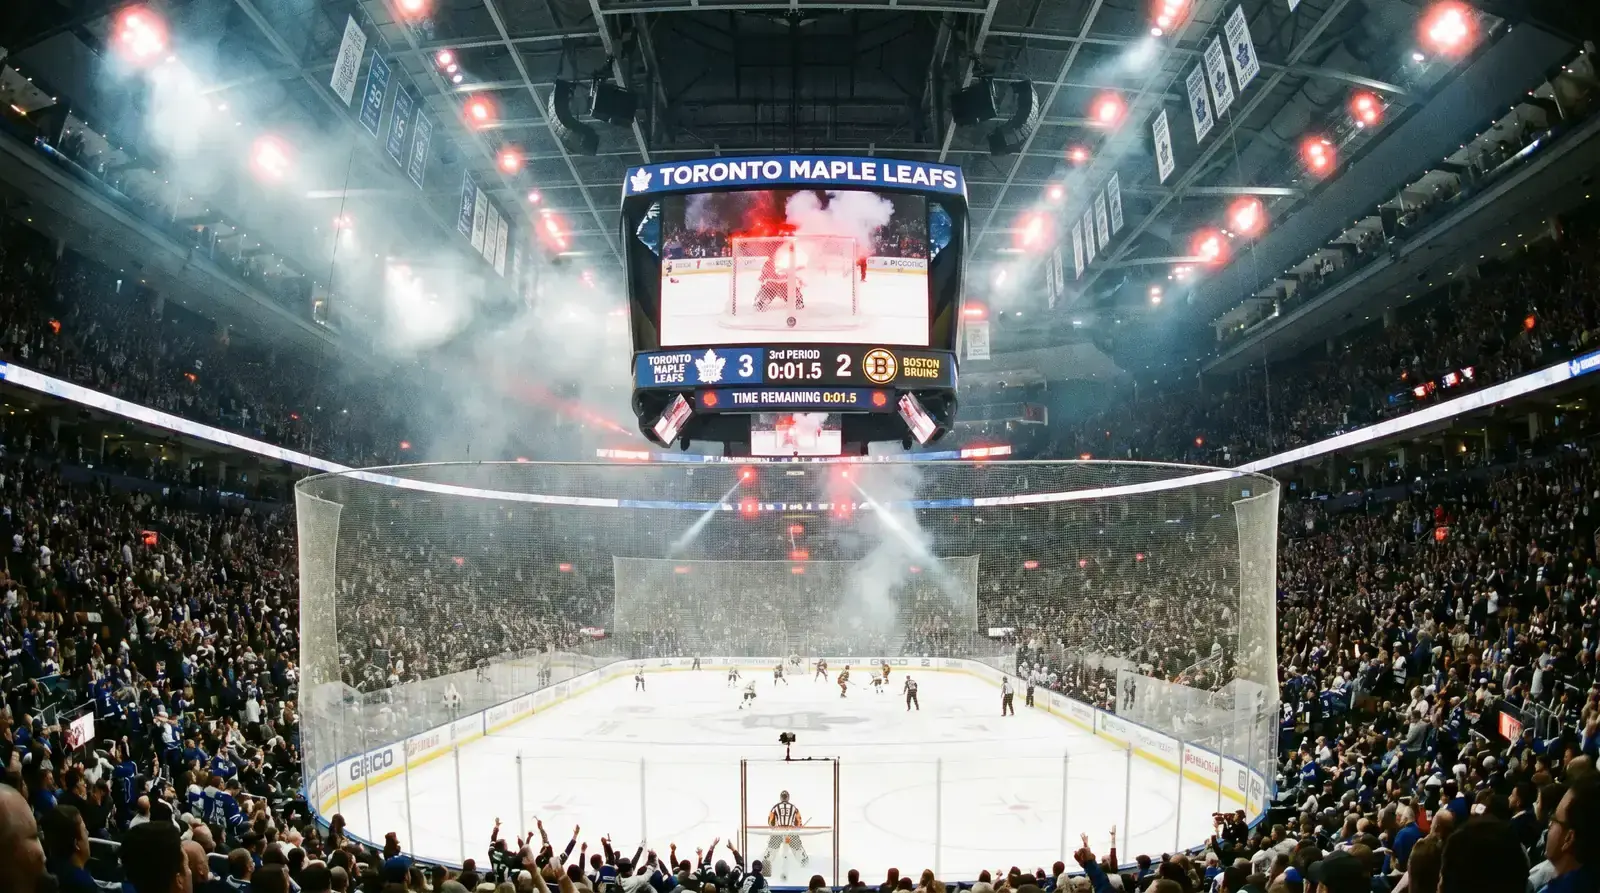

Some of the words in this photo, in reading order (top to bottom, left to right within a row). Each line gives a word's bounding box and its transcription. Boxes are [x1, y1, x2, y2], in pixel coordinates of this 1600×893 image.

[659, 159, 783, 186] TORONTO
[789, 160, 877, 182] MAPLE
[883, 163, 958, 189] LEAFS
[648, 353, 692, 366] TORONTO
[769, 350, 785, 360] 3rd
[786, 349, 821, 360] PERIOD
[653, 363, 685, 375] MAPLE
[738, 354, 754, 378] 3
[836, 353, 852, 377] 2
[873, 356, 887, 375] B
[903, 357, 940, 369] BOSTON
[767, 362, 822, 380] 0:01.5
[904, 367, 939, 379] BRUINS
[654, 373, 684, 384] LEAFS
[732, 392, 759, 404] TIME
[760, 391, 821, 403] REMAINING
[822, 391, 857, 403] 0:01.5
[350, 749, 393, 781] GEICO
